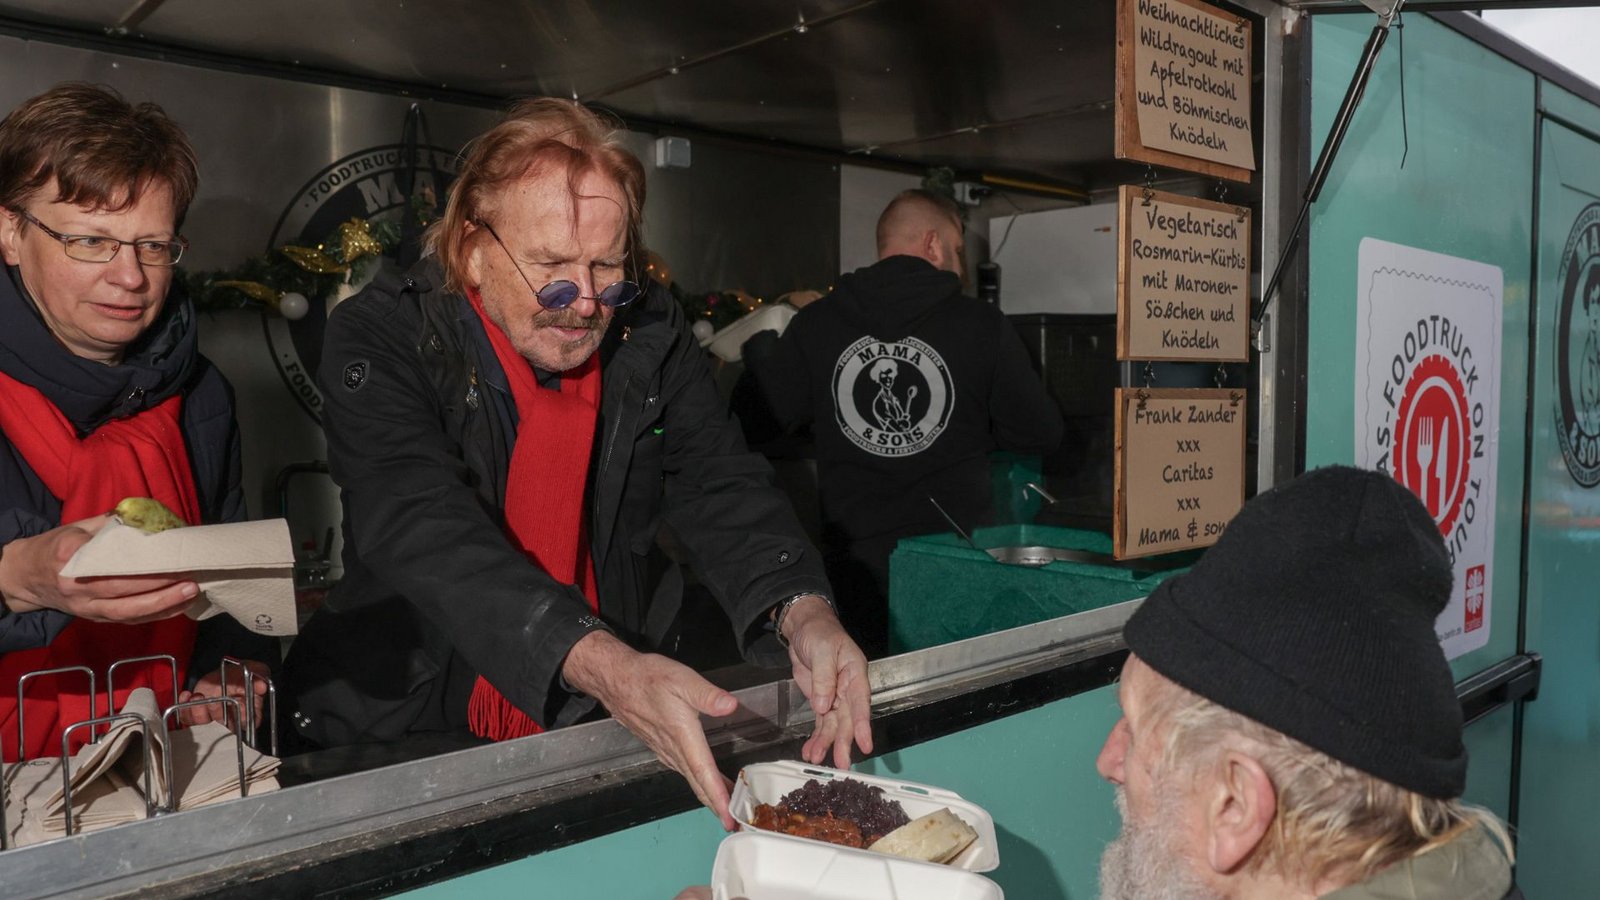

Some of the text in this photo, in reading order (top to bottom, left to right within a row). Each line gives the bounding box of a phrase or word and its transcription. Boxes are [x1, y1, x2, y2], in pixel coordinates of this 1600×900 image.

[1138, 0, 1245, 50] Weihnachtliches
[1140, 27, 1244, 76] Wildragout mit
[1150, 60, 1237, 101] Apfelrotkohl
[1138, 91, 1249, 131] und Böhmischen
[1169, 122, 1228, 151] Knödeln
[356, 169, 438, 213] MA
[1146, 205, 1237, 240] Vegetarisch
[1132, 239, 1246, 270] Rosmarin-Kürbis
[1142, 270, 1238, 295] mit Maronen-
[1145, 299, 1235, 322] Sößchen und
[1162, 329, 1220, 350] Knödeln
[857, 344, 922, 366] MAMA
[1376, 315, 1479, 474] AS-FOODTRUCK
[1472, 402, 1484, 459] ON
[1135, 403, 1237, 425] Frank Zander
[862, 426, 924, 446] & SONS
[1176, 439, 1201, 453] xxx
[1162, 462, 1214, 483] Caritas
[1177, 497, 1201, 512] xxx
[1138, 518, 1228, 547] Mama & son
